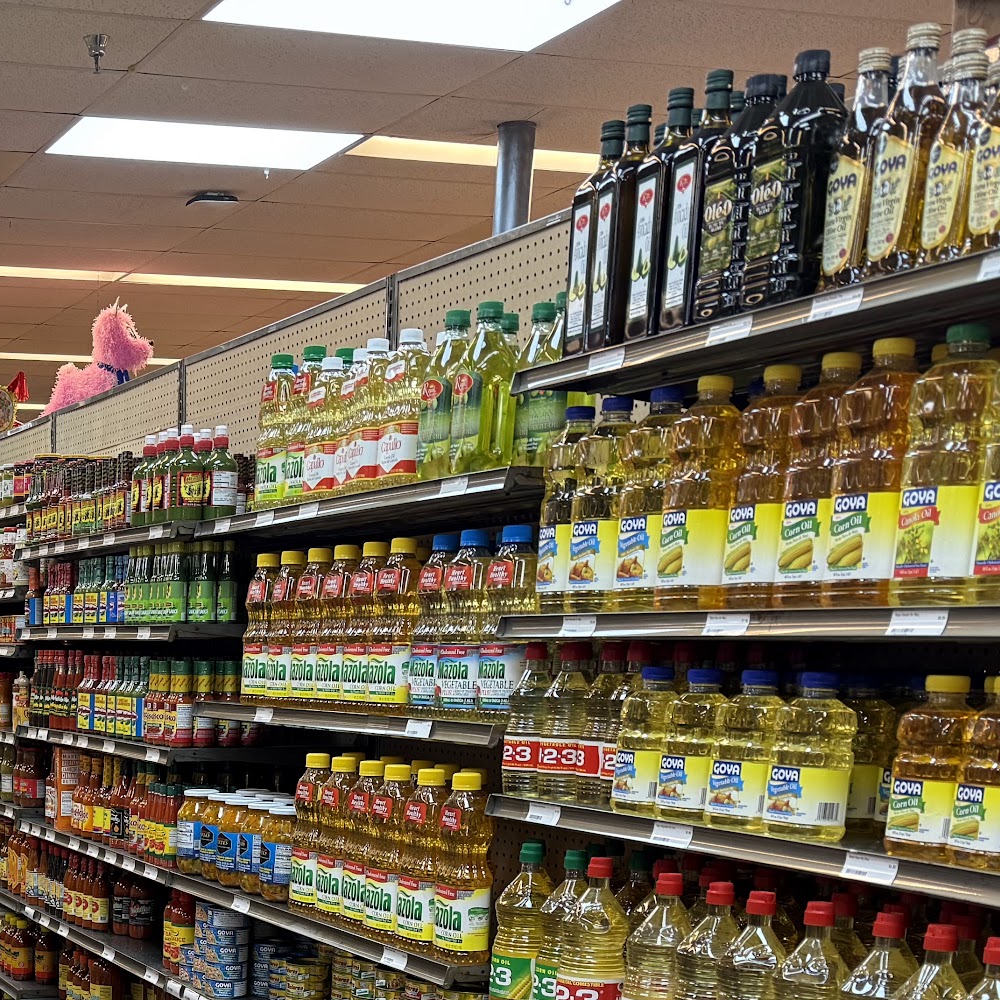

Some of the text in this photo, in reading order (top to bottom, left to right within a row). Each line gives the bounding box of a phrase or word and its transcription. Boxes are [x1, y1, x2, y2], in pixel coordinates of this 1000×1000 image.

[929, 161, 957, 180] GOYA
[828, 173, 857, 195] GOYA
[381, 437, 402, 454] Capullo
[835, 496, 866, 512] GOYA
[903, 489, 935, 506] GOYA
[730, 507, 754, 520] GOYA
[785, 502, 816, 516] GOYA
[663, 512, 686, 526] GOYA
[834, 515, 862, 534] Corn Oil
[901, 509, 932, 526] Canola Oil
[573, 523, 597, 537] GOYA
[620, 518, 646, 532] GOYA
[741, 524, 751, 535] Oil
[784, 520, 813, 538] Corn Oil
[674, 529, 683, 539] Oil
[493, 565, 507, 573] Heart
[409, 659, 434, 677] Mazola
[438, 661, 469, 680] Mazola
[478, 661, 506, 680] Mazola
[441, 680, 477, 689] VEGETABLE
[480, 680, 514, 689] VEGETABLE
[617, 751, 634, 764] GOYA
[662, 756, 684, 770] GOYA
[713, 761, 740, 775] GOYA
[772, 768, 799, 782] GOYA
[894, 780, 922, 796] GOYA
[957, 789, 983, 802] GOYA
[893, 799, 919, 810] Corn Oil
[956, 805, 979, 815] Corn Oil
